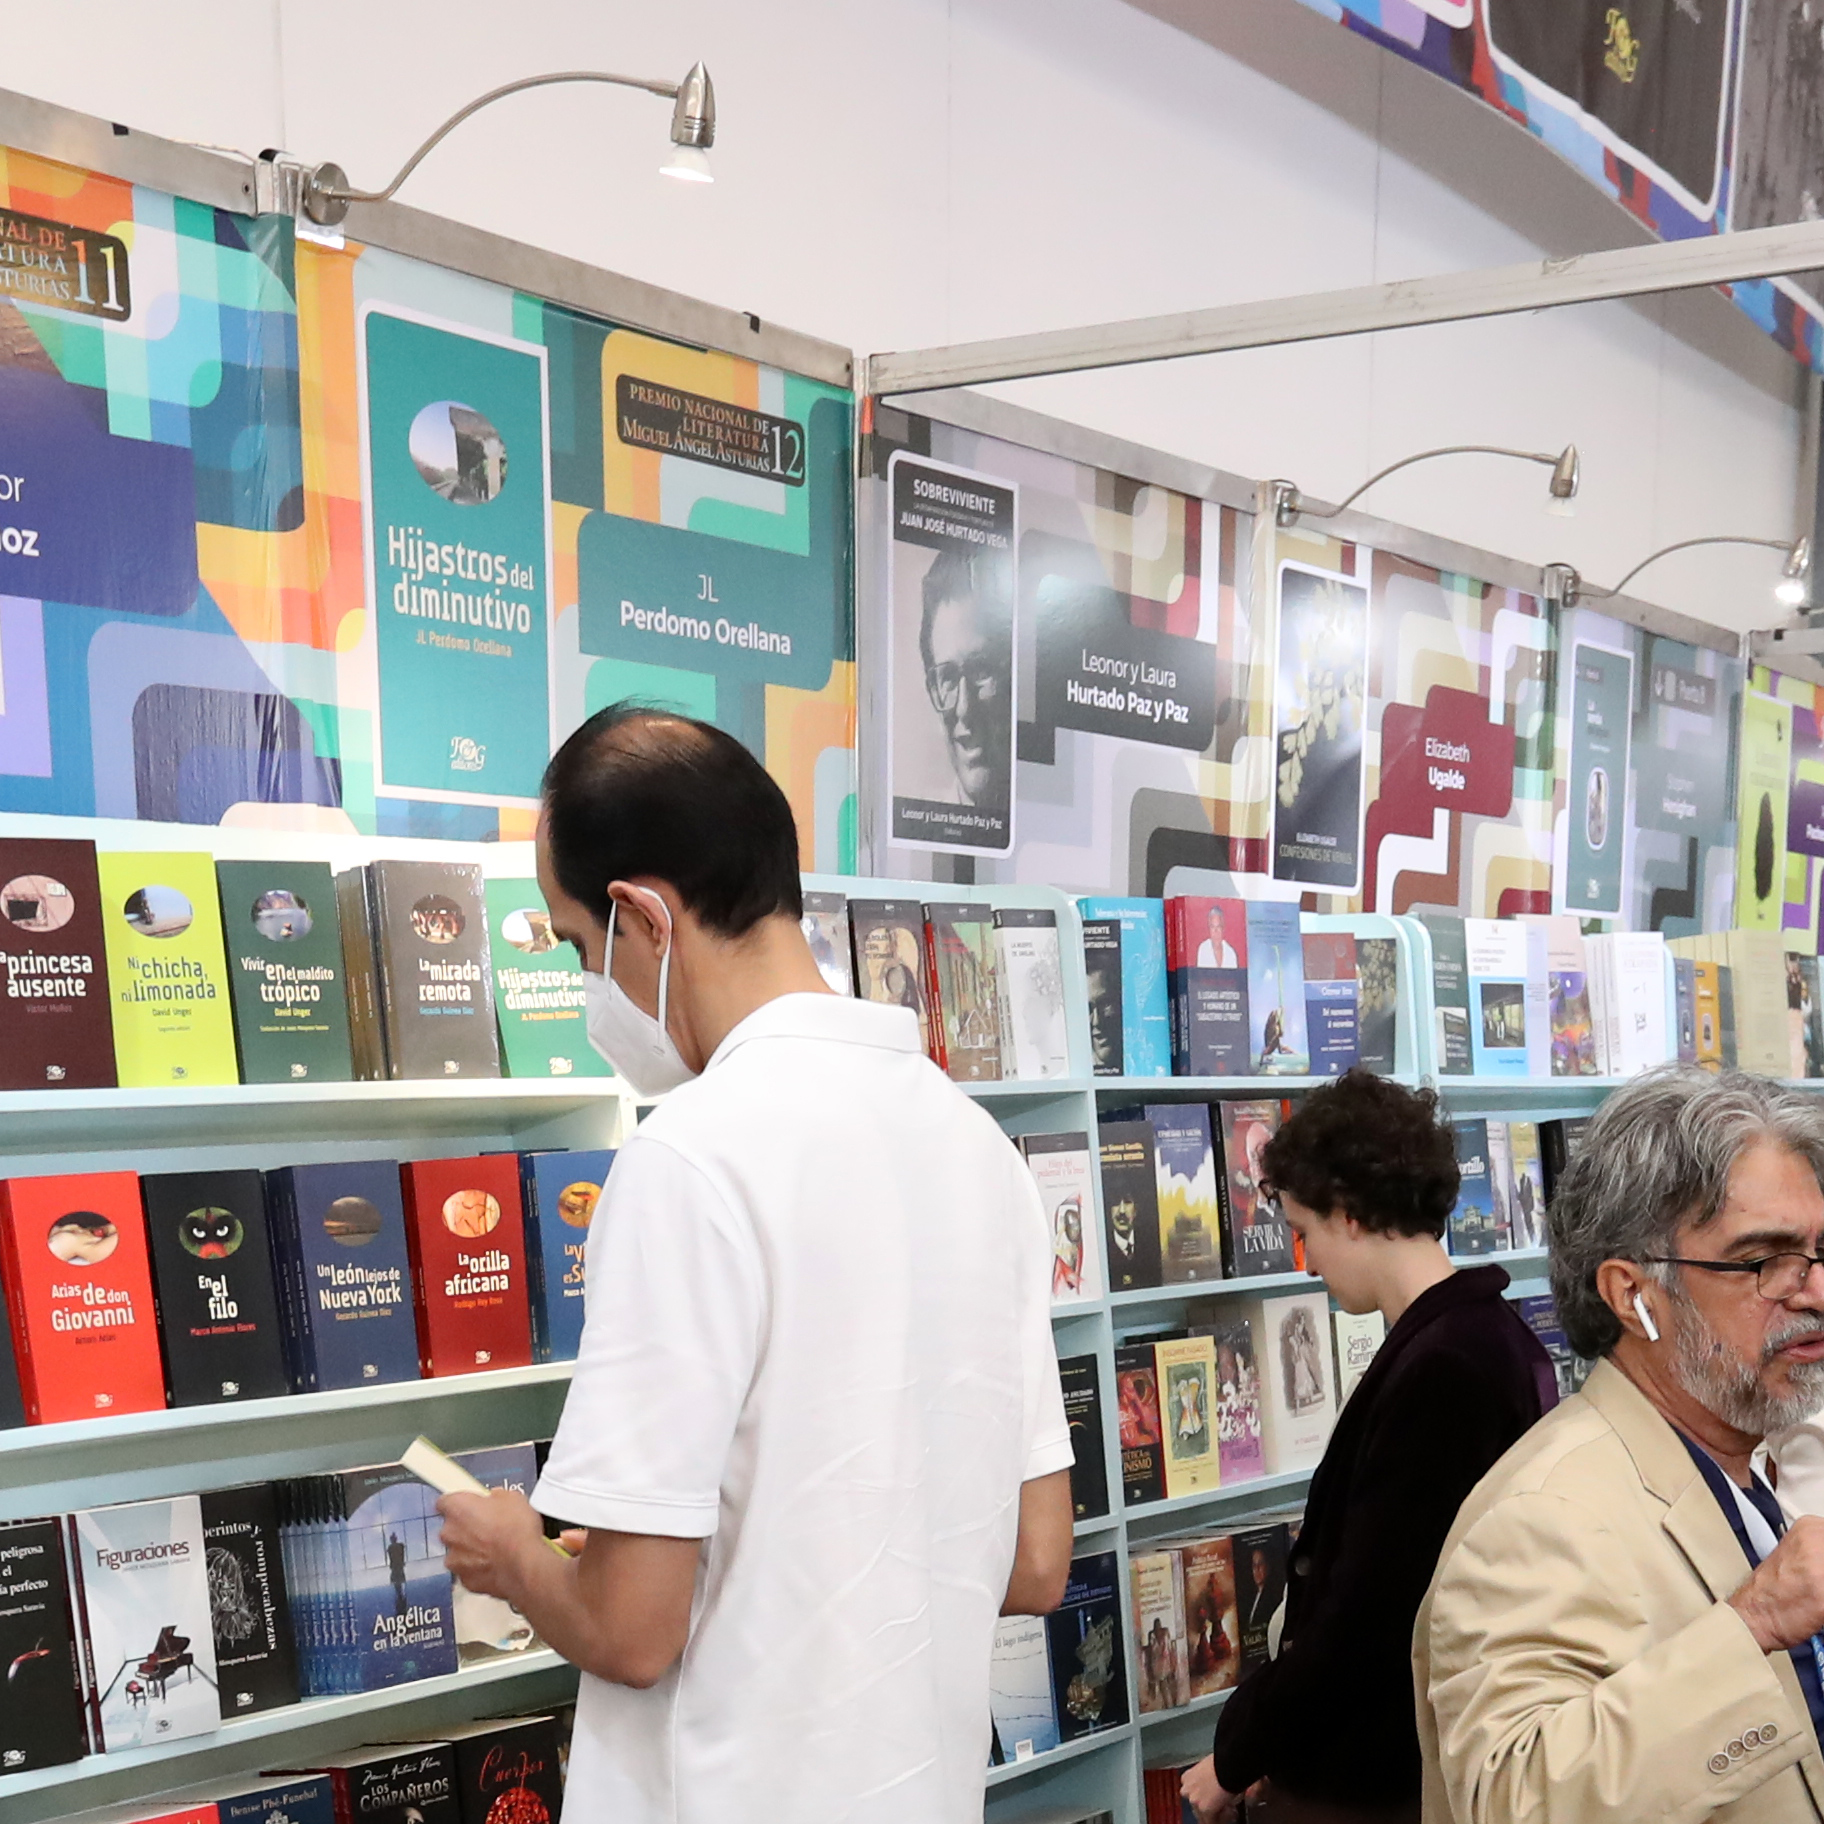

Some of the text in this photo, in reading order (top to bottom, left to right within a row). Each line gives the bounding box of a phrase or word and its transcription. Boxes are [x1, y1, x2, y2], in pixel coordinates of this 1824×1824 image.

[39, 227, 67, 251] DE
[71, 240, 124, 312] 11
[629, 383, 770, 435] PREMIO NACIONAL DE
[622, 416, 770, 473] MIGUEL ÁNGEL ASTURIAS
[683, 417, 769, 453] LITERATURA
[770, 425, 804, 479] 12
[913, 478, 996, 515] SOBREVIVIENTE
[387, 526, 534, 592] Hijastros del
[696, 575, 719, 603] JL
[392, 575, 531, 635] diminutivo
[620, 600, 792, 656] Perdomo Orellana
[1081, 649, 1177, 689] Leonor y Laura
[1066, 680, 1189, 725] Hurtado Paz y Paz
[1425, 737, 1470, 764] Elizabeth
[1427, 766, 1466, 791] Ugalde
[7, 950, 93, 979] princesa
[127, 957, 208, 981] Ni chicha,
[241, 956, 334, 981] Vivir en el maldito
[419, 958, 481, 982] La mirada
[7, 974, 87, 998] ausente
[121, 980, 216, 1002] ni limonada
[260, 981, 321, 1006] trópico
[419, 982, 471, 1001] remota
[1243, 1224, 1283, 1238] SERVIR A
[1244, 1235, 1284, 1253] LA VIDA
[317, 1262, 401, 1286] Un león lejos de
[458, 1250, 510, 1274] La orilla
[51, 1282, 129, 1306] Arias de don
[198, 1275, 228, 1298] En el
[319, 1281, 402, 1310] Nueva York
[445, 1274, 509, 1297] africana
[51, 1304, 134, 1332] Giovanni
[208, 1297, 238, 1319] filo
[95, 1539, 190, 1570] Figuraciones
[373, 1606, 441, 1639] Angélica
